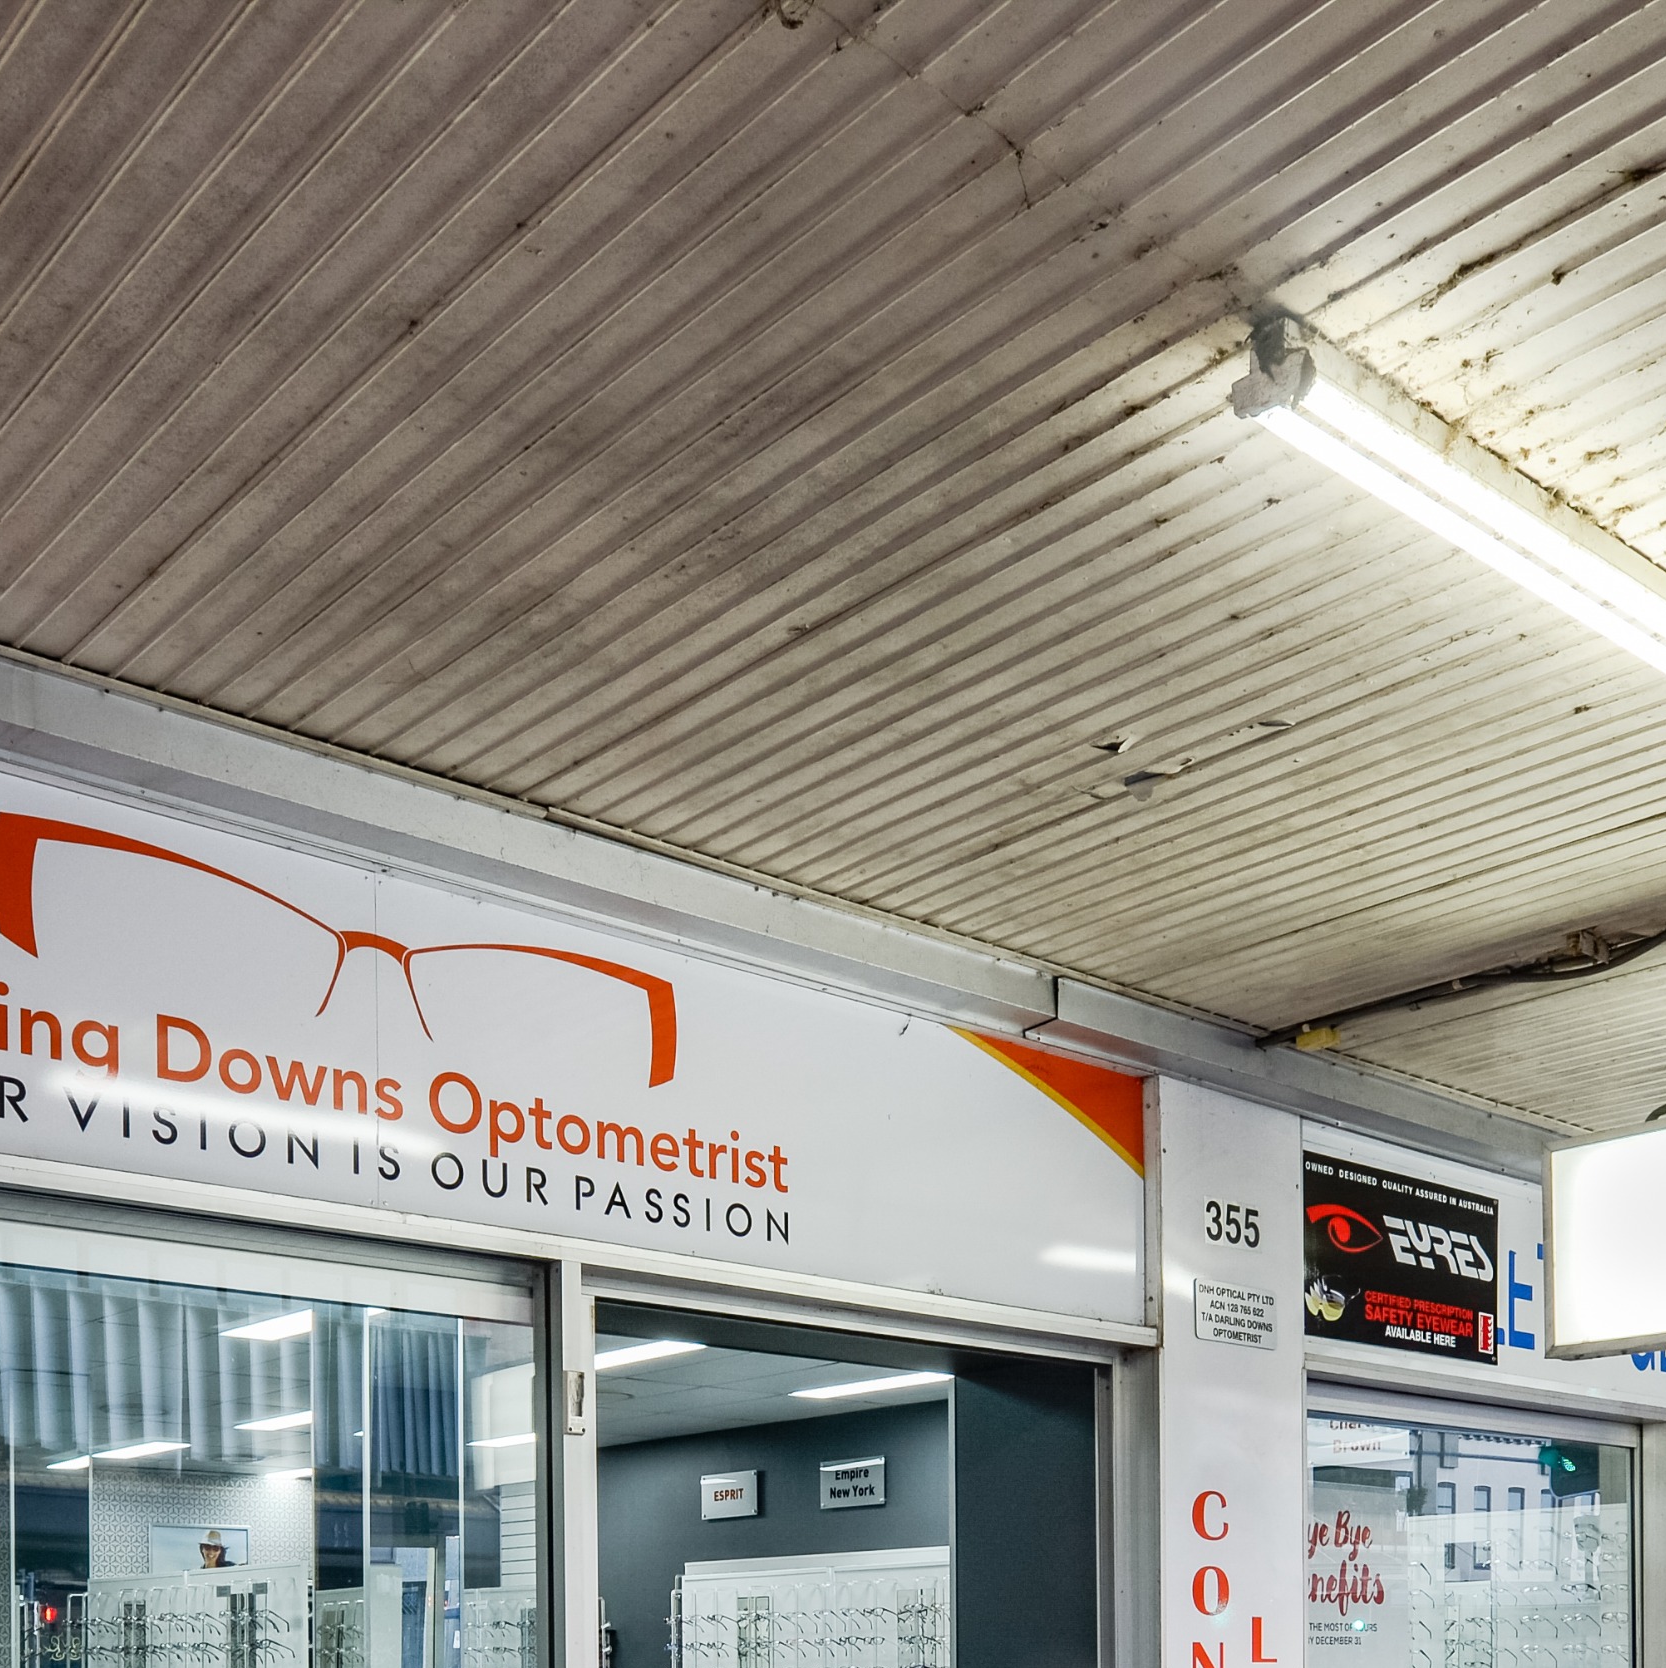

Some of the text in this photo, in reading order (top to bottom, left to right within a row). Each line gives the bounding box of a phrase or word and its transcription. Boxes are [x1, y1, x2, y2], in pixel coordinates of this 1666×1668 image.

[156, 1013, 404, 1121] Downs
[429, 1071, 789, 1193] Optometrist
[63, 1086, 319, 1170] VISION
[352, 1136, 401, 1181] IS
[431, 1152, 548, 1206] OUR
[574, 1175, 790, 1245] PASSION
[1305, 1161, 1494, 1215] OWNED DESIGNED QUALITY ASSURED IN AUSTRALIA
[1205, 1200, 1260, 1248] 355
[1210, 1300, 1225, 1310] ACN
[1216, 1287, 1246, 1300] OPTICAL
[1247, 1292, 1260, 1303] PTY
[1262, 1295, 1274, 1306] LTD
[1364, 1290, 1473, 1320] CERTIFIED PRESCRIPTION
[1201, 1312, 1273, 1332] T/A DARLING DOWNS
[1365, 1304, 1413, 1327] SAFETY
[1417, 1313, 1473, 1337] EYEWEAR
[1213, 1328, 1262, 1344] OPTOMETRIST
[1385, 1325, 1456, 1348] AVAILABLE HERE
[835, 1467, 869, 1482] Empire
[714, 1488, 744, 1502] ESPRIT
[829, 1485, 875, 1500] New York
[1308, 1510, 1373, 1561] ye Bye
[1308, 1560, 1384, 1616] nefits
[1309, 1623, 1322, 1631] THE
[1324, 1623, 1343, 1632] MOST
[1315, 1636, 1353, 1645] DECEMBER
[1354, 1636, 1362, 1645] 31
